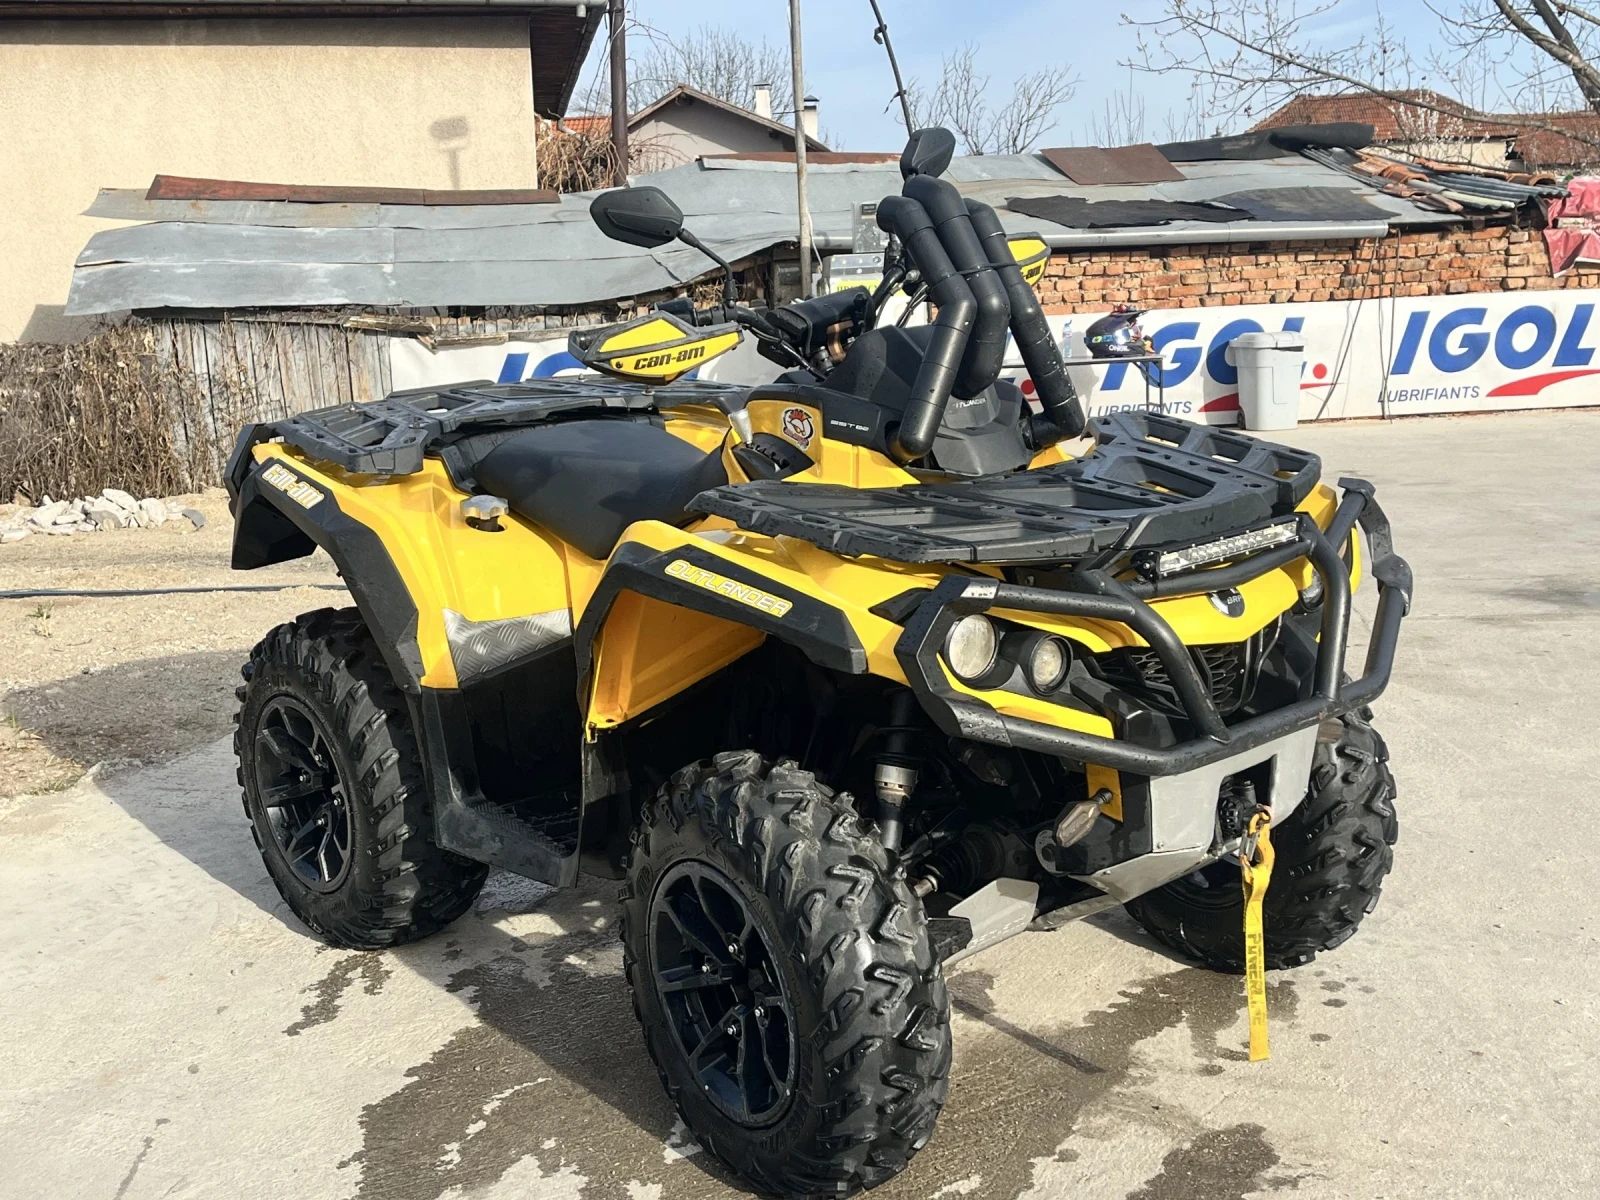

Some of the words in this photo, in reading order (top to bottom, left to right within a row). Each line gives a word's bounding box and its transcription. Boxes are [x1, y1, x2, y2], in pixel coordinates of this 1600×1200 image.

[1390, 304, 1596, 375] IGOL
[1378, 386, 1480, 403] LUBRIFIANTS
[665, 560, 792, 617] OUTLANDER
